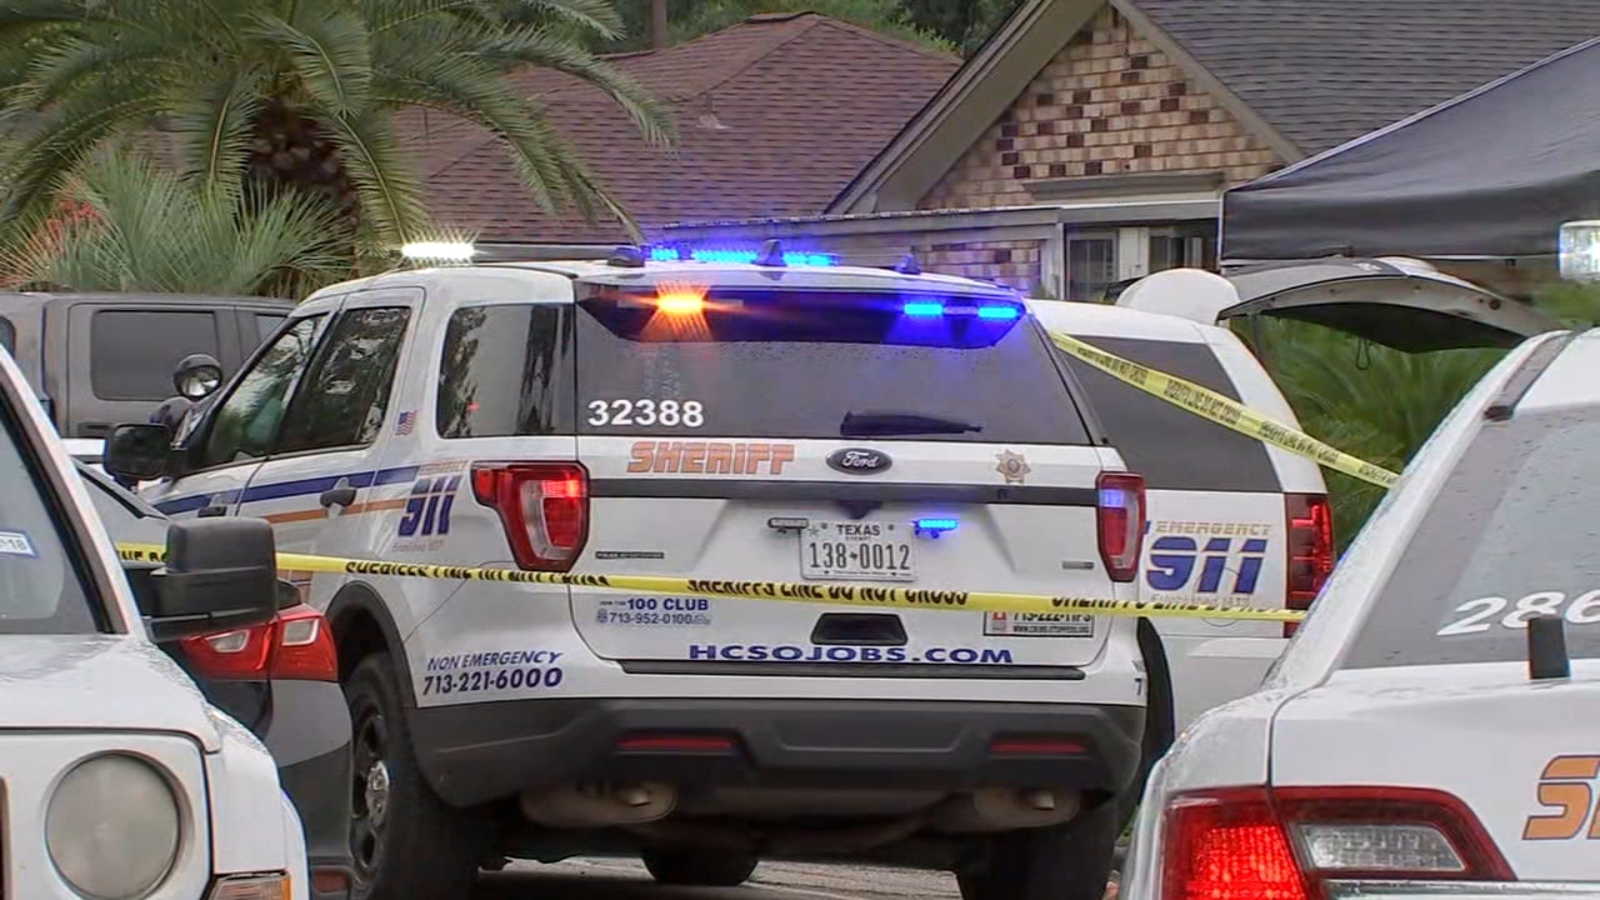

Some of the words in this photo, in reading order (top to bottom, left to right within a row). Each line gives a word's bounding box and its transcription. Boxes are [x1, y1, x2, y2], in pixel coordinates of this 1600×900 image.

[588, 400, 703, 427] 32388
[626, 441, 796, 475] SHERIFF
[842, 450, 879, 468] Ford
[398, 475, 461, 536] 911
[836, 524, 880, 536] TEXAS
[1155, 520, 1272, 536] EMERGENCY
[1145, 535, 1269, 594] 911
[627, 598, 658, 611] 100
[663, 598, 709, 611] CLUB
[609, 612, 692, 625] 713-952-0100
[427, 656, 459, 672] NON
[462, 650, 563, 668] EMERGENCY
[689, 644, 1013, 664] HCSOJOBS.COM
[1521, 754, 1600, 841] S
